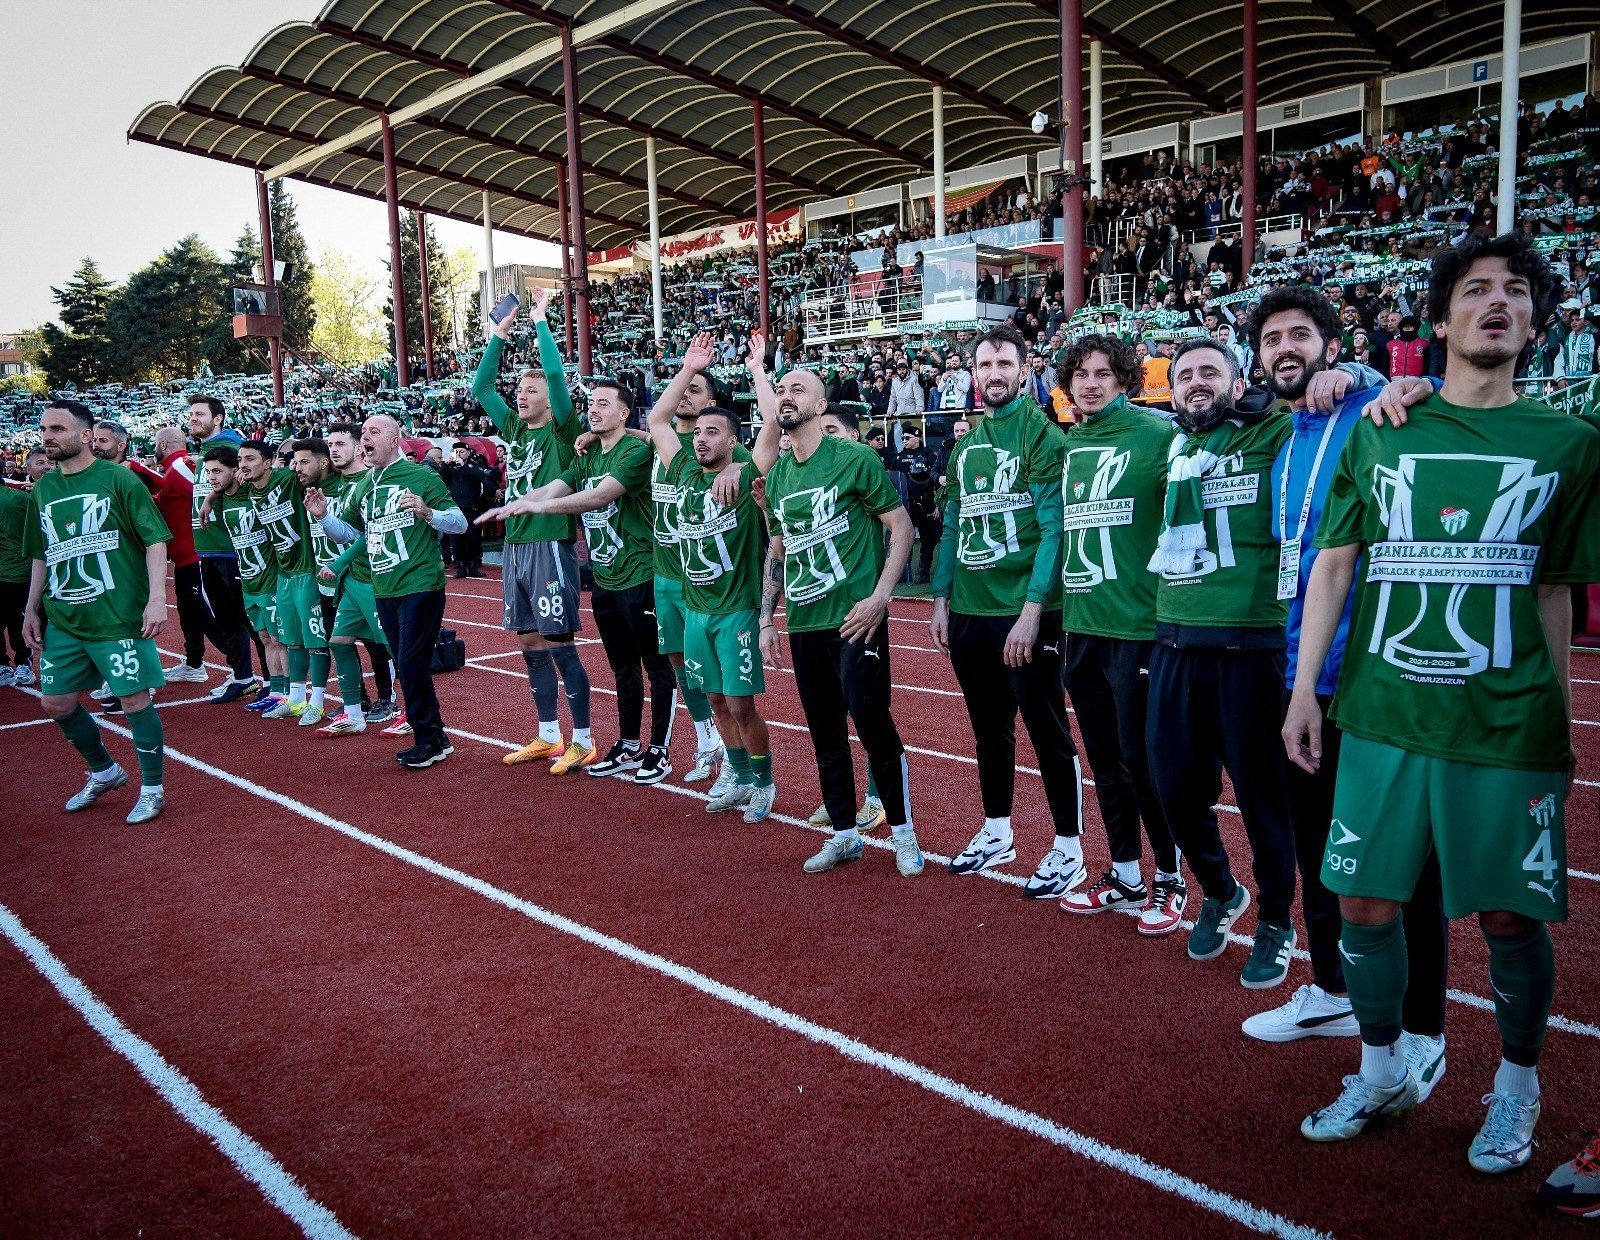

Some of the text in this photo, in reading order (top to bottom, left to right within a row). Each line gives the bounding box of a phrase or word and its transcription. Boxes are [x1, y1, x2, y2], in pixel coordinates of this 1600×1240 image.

[1476, 66, 1486, 78] F
[1364, 261, 1427, 274] BURSASPOR
[1086, 500, 1131, 512] KUPALAR
[1370, 546, 1467, 559] ZANILACAK
[1369, 567, 1416, 577] ANILACAK
[1418, 568, 1526, 579] ŞAMPİYONLUKLAR
[538, 595, 563, 617] 98
[110, 650, 140, 677] 35
[739, 648, 753, 674] 3
[1523, 830, 1557, 880] 4
